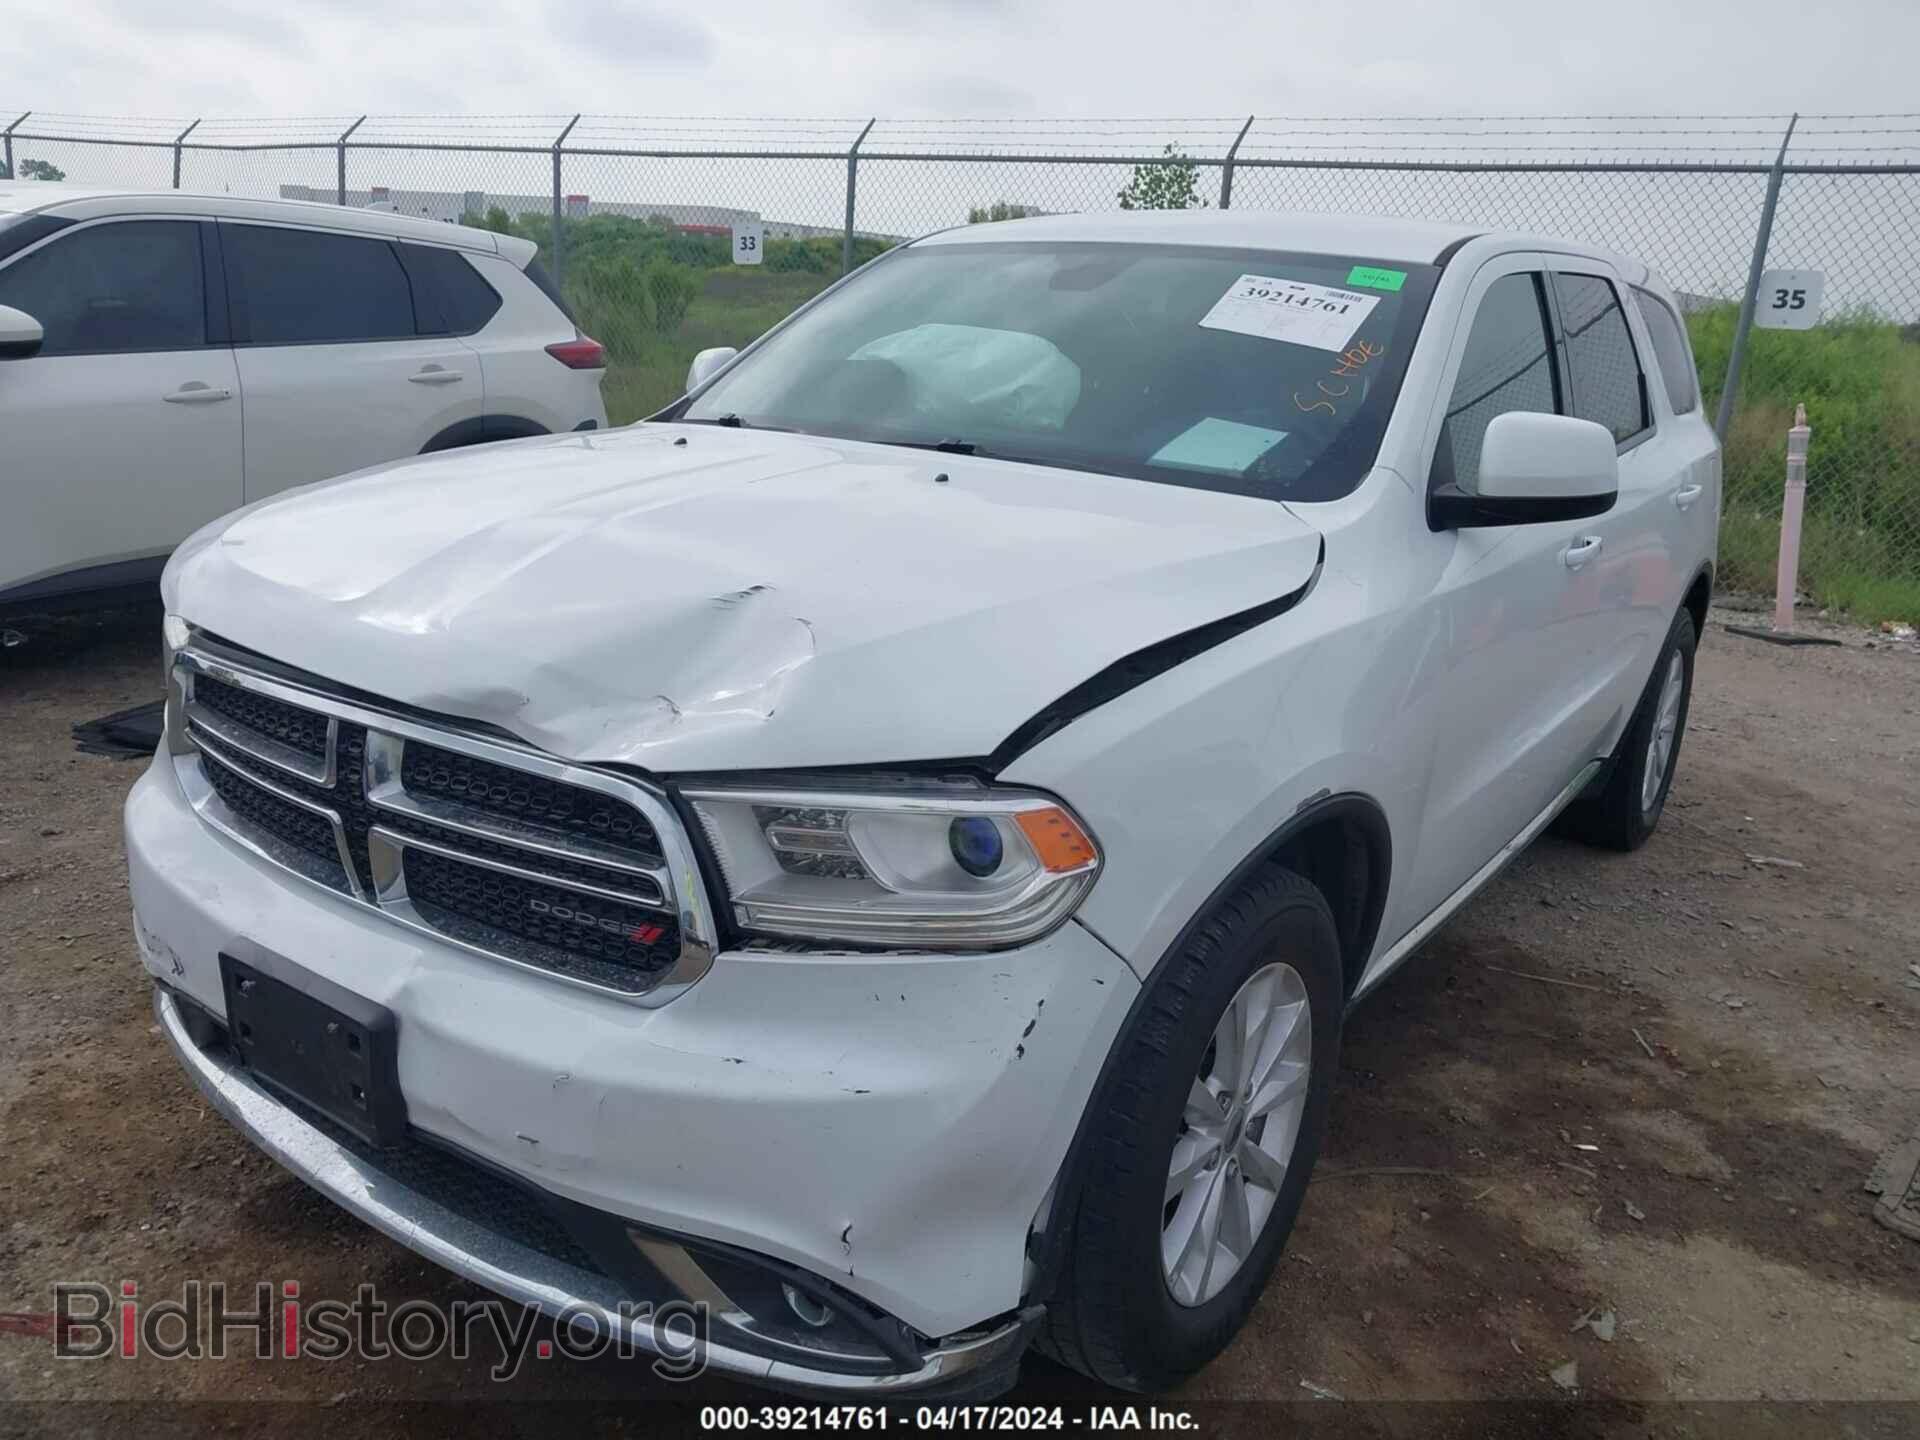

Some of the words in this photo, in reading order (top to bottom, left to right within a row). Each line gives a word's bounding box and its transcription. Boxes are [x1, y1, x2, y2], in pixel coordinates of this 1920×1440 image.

[740, 236, 756, 250] 33
[1240, 287, 1350, 315] 39214761
[1772, 288, 1806, 310] 35
[530, 899, 641, 936] DODGE
